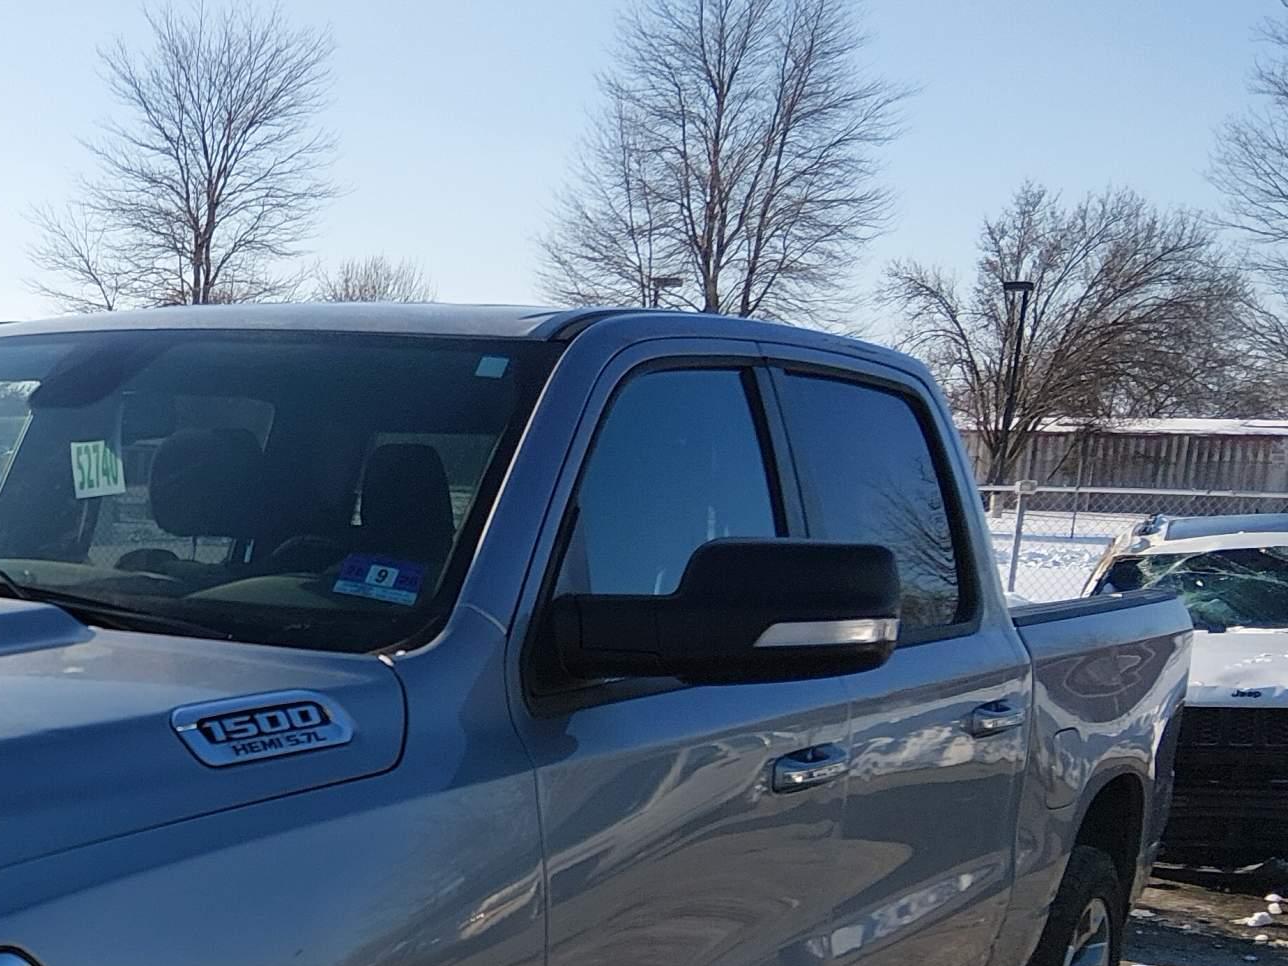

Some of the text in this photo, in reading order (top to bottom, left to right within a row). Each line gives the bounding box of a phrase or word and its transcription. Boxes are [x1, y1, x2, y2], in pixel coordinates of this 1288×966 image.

[76, 445, 118, 490] 52740
[375, 568, 389, 583] 9
[1231, 689, 1262, 698] Jeep
[203, 705, 322, 742] 1500
[231, 731, 328, 757] HEMI 5.7L
